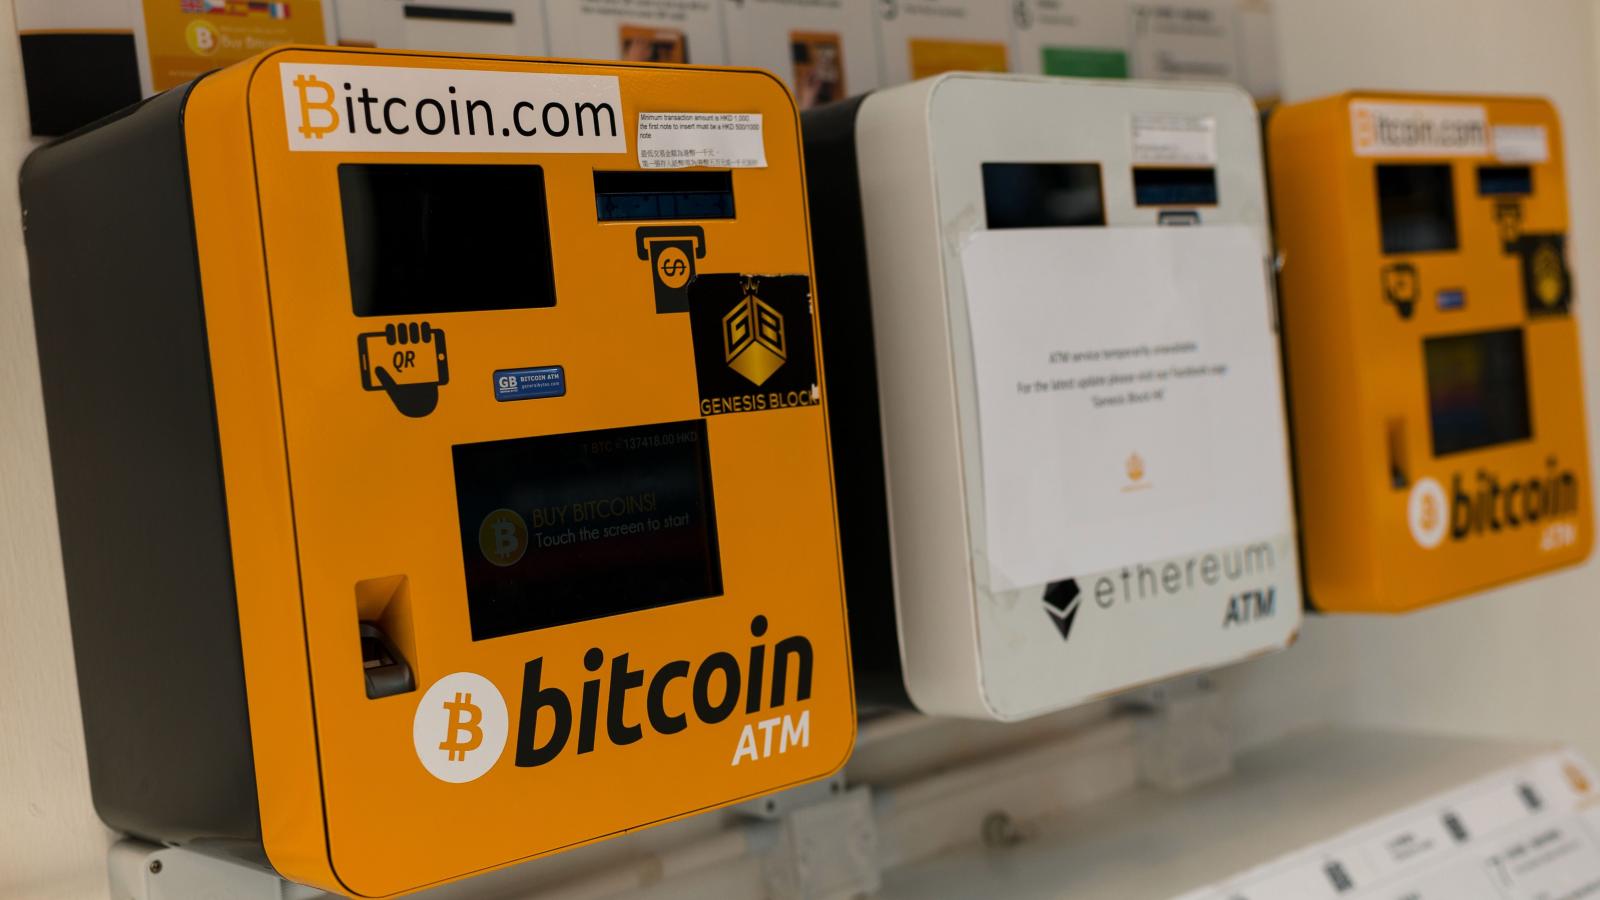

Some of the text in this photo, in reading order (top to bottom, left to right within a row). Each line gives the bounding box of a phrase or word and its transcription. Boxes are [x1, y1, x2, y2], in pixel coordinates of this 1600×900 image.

[292, 74, 617, 139] Bitcoin.com
[393, 351, 416, 373] QR
[520, 374, 546, 382] BITCOIN
[499, 376, 518, 388] GB
[701, 393, 767, 415] GENESIS
[592, 439, 614, 454] BTC
[676, 431, 698, 444] HKD
[534, 491, 657, 529] BUY BITCOINS!
[1451, 456, 1577, 540] bitcoin
[535, 511, 689, 548] Touch the screen to start
[1094, 542, 1276, 609] ethereum
[1222, 586, 1276, 629] ATM
[514, 614, 814, 769] bitcoin
[730, 710, 811, 767] ATM
